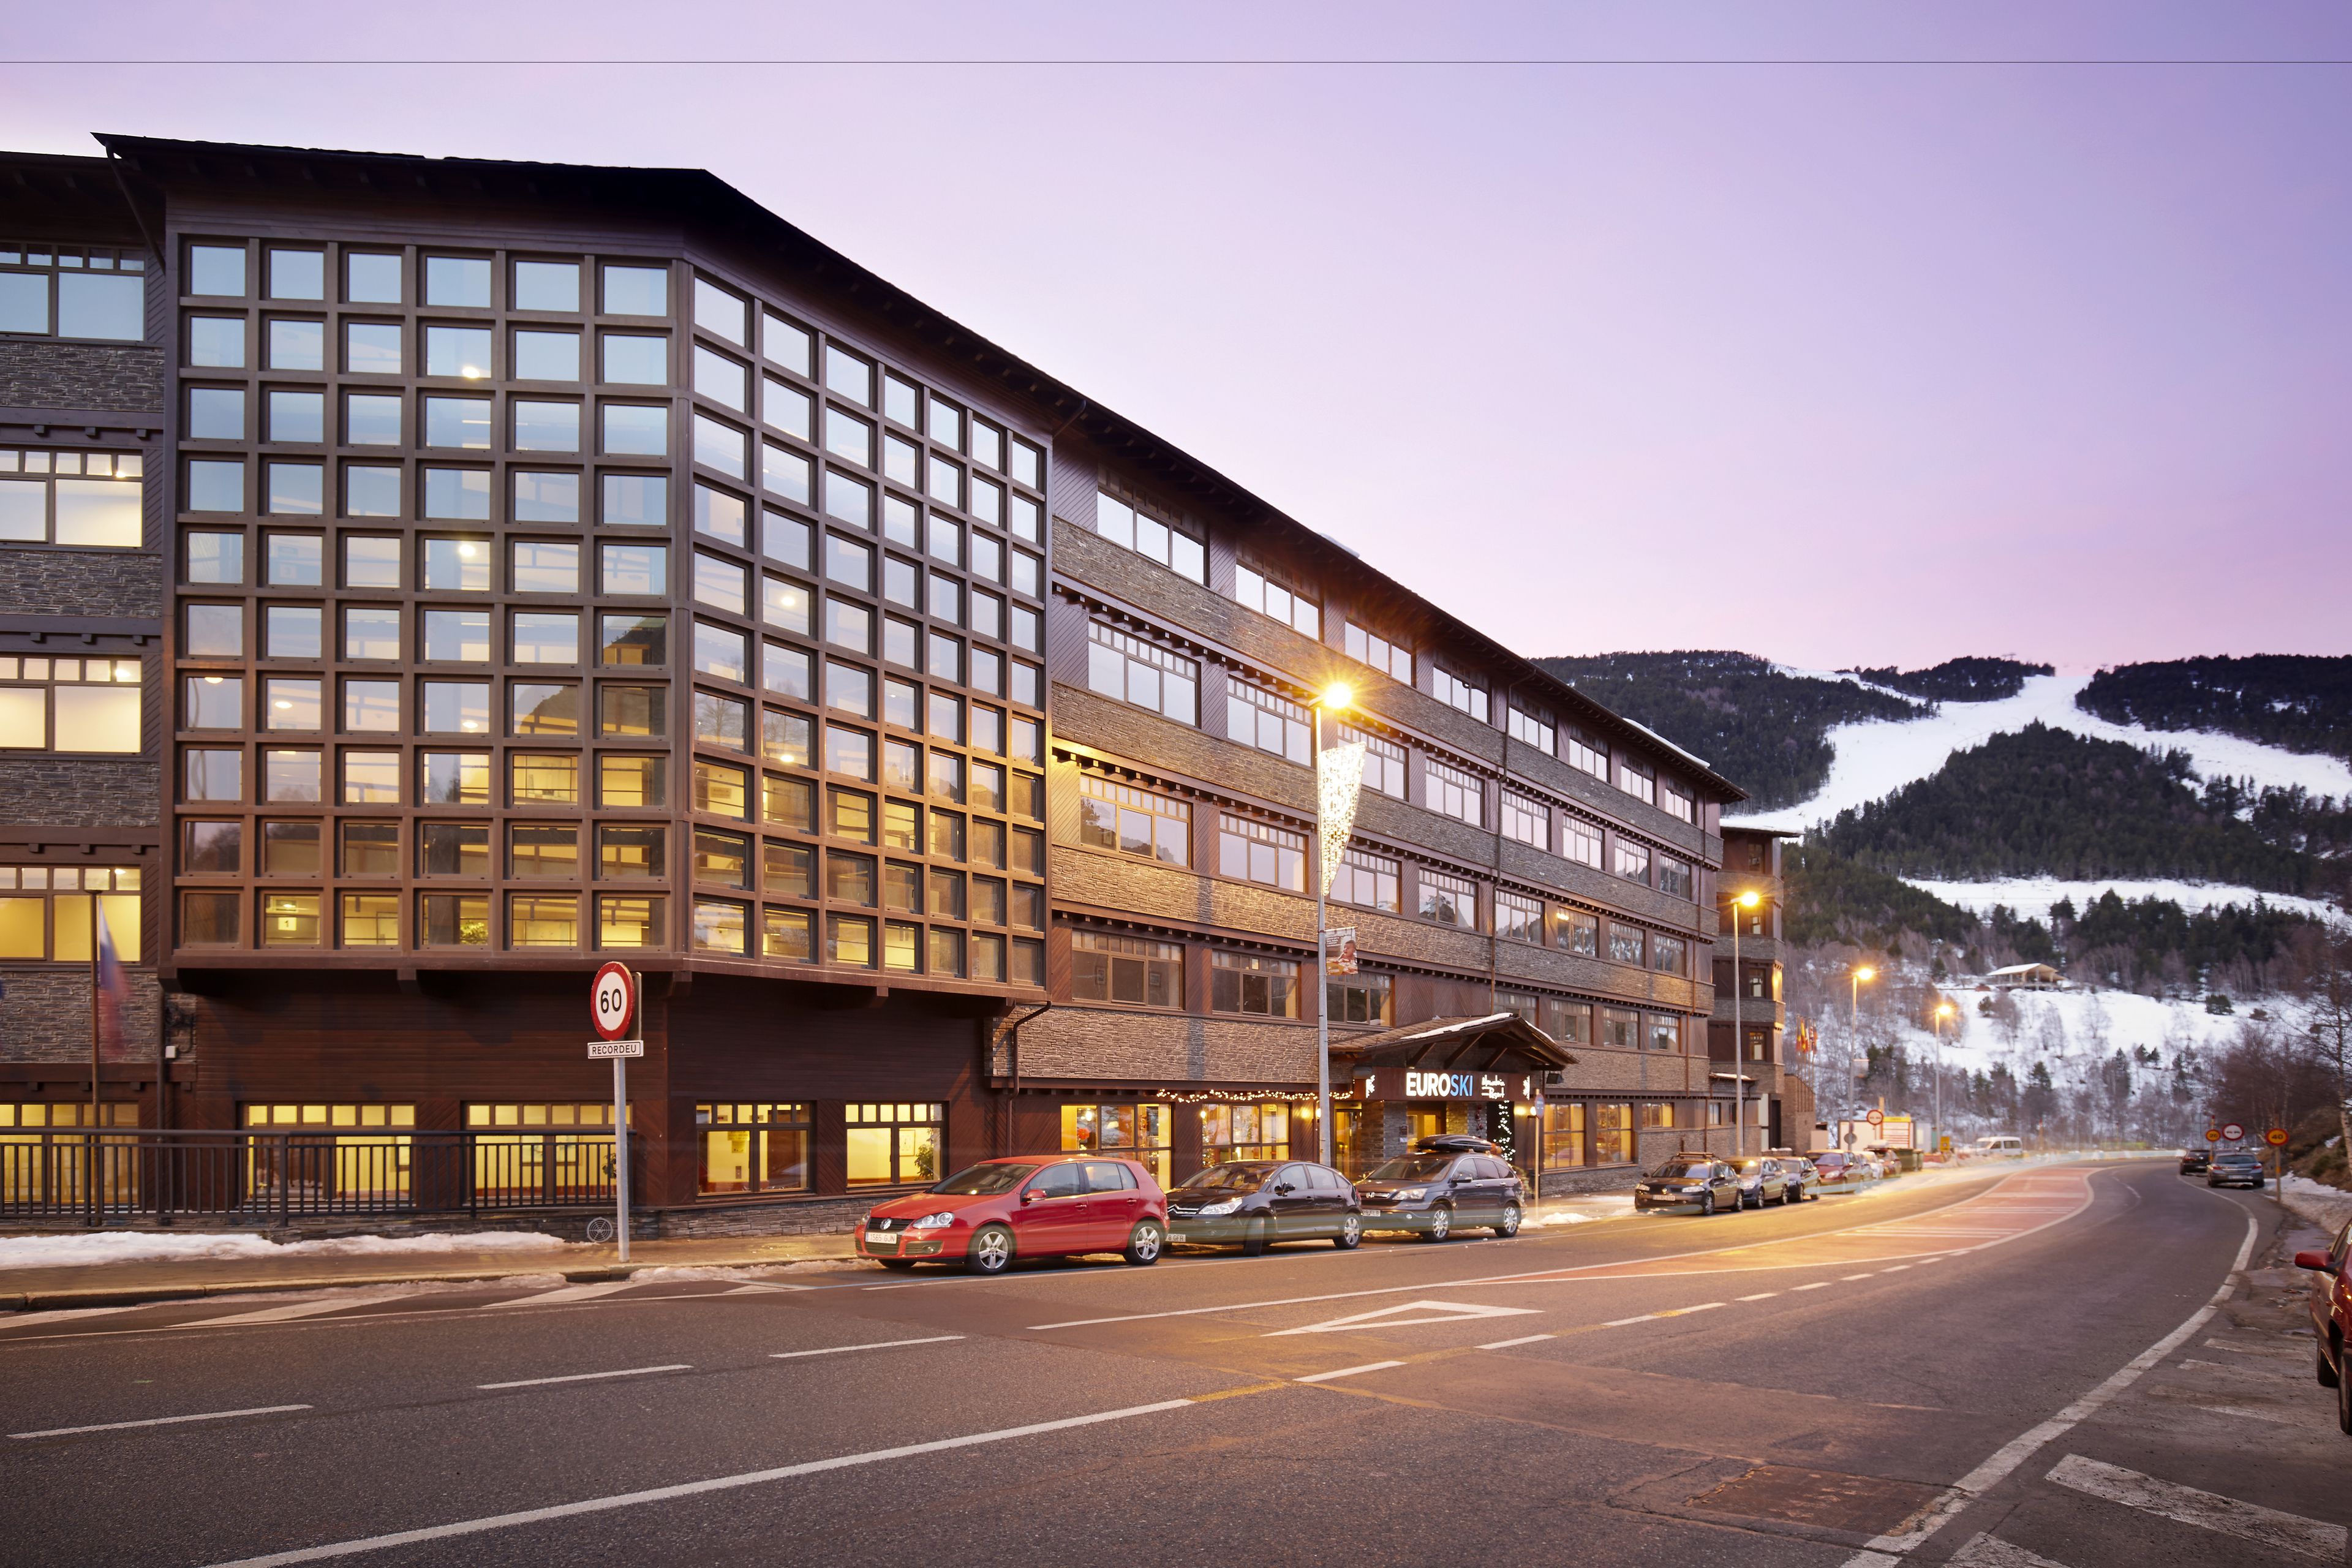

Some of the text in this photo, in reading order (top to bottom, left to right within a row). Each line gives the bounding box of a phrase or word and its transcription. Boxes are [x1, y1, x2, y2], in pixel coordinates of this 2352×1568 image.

[600, 988, 622, 1014] 60
[592, 1044, 636, 1055] RECORDEU
[1406, 1072, 1473, 1097] EUROSKI
